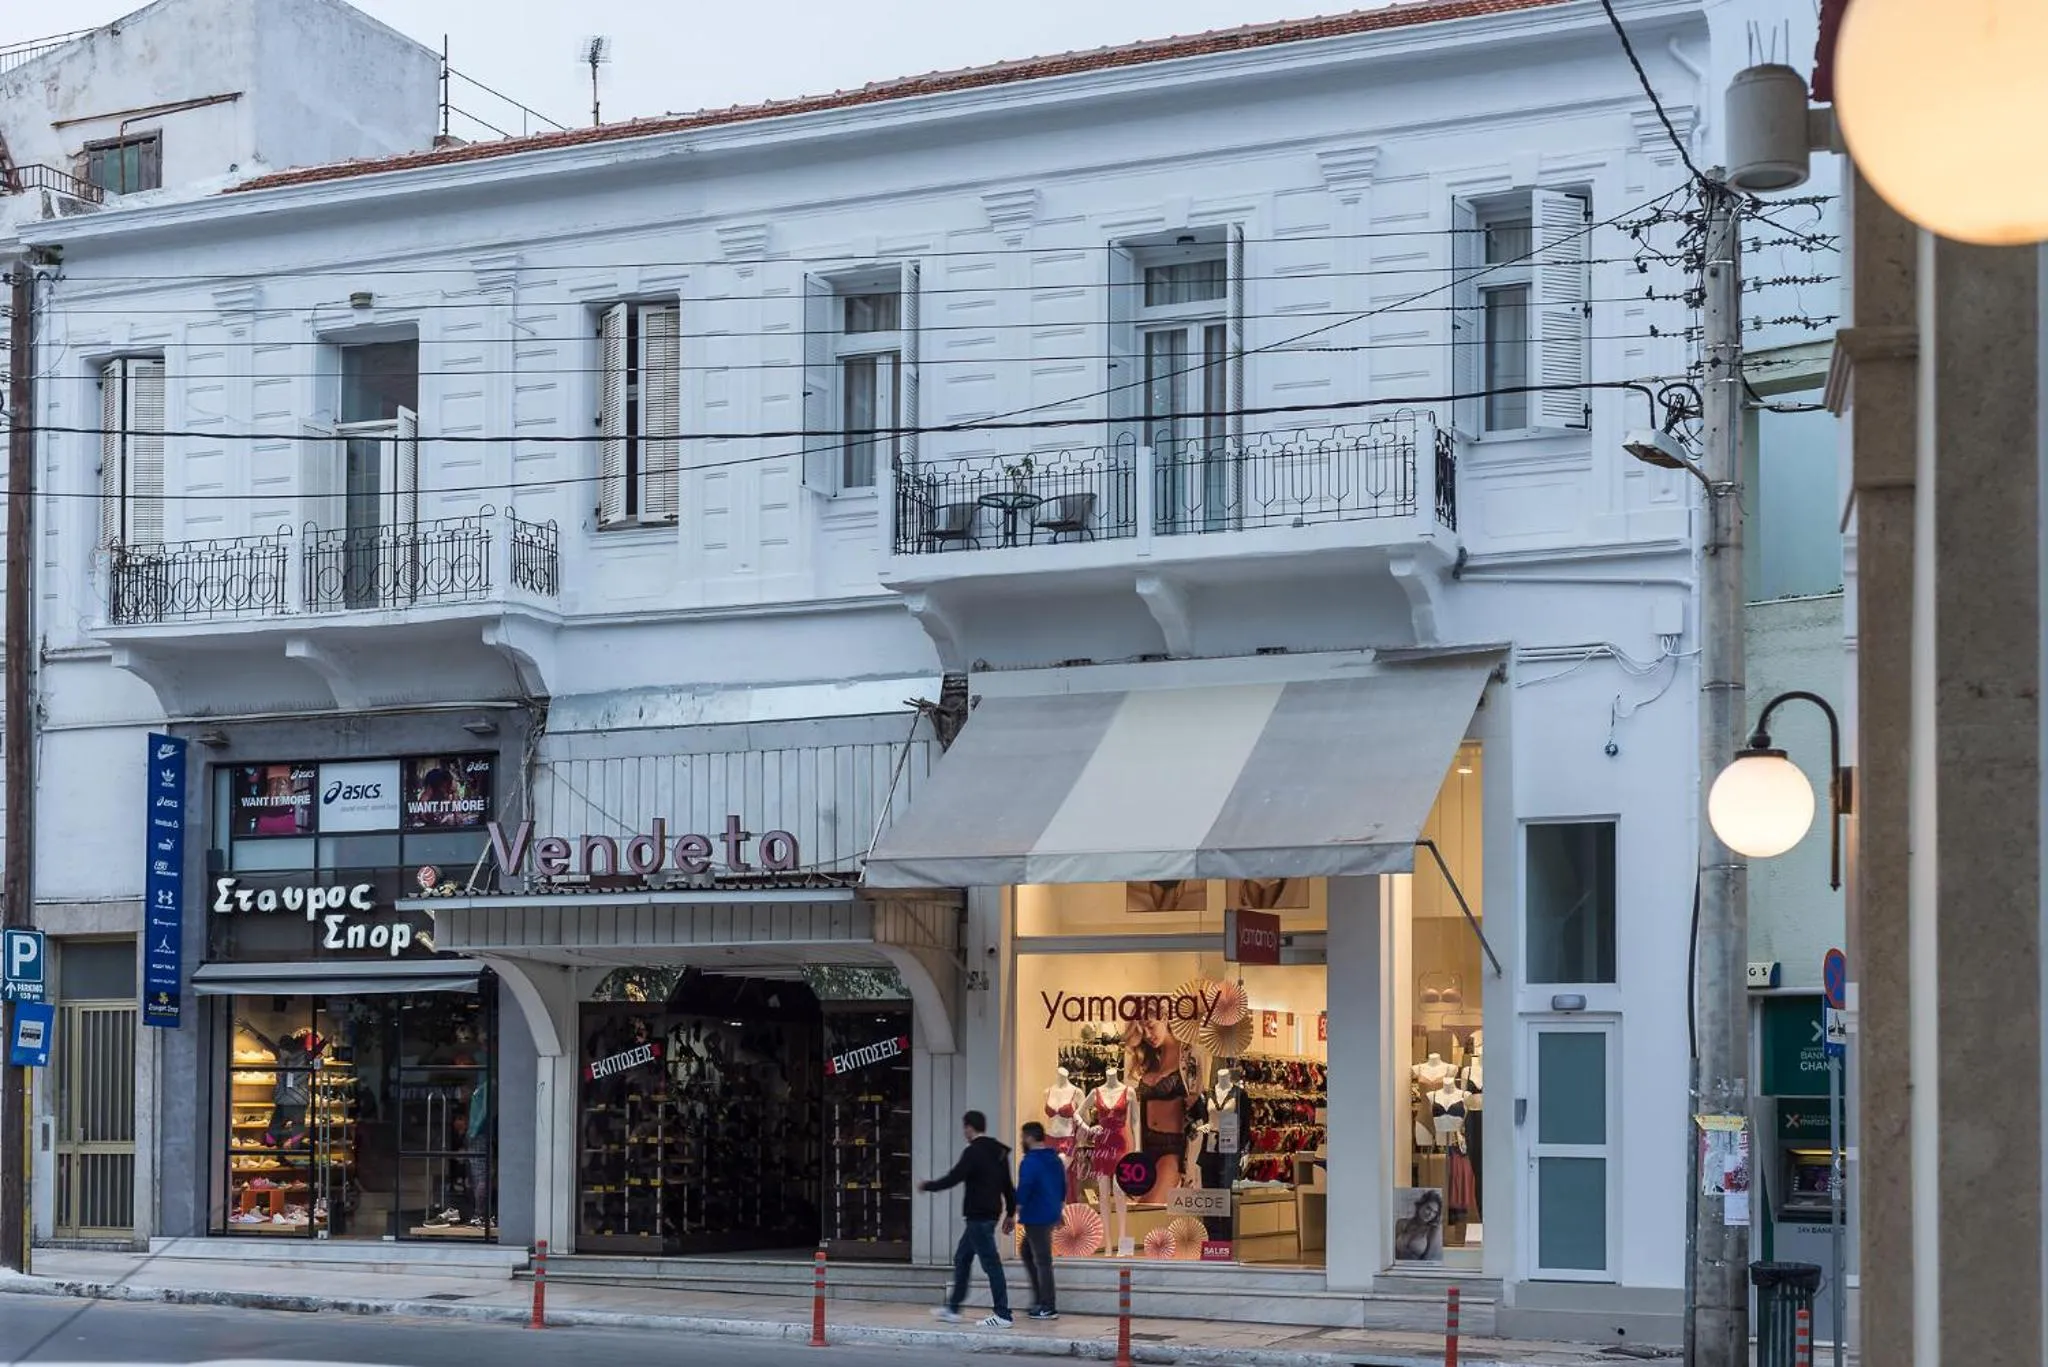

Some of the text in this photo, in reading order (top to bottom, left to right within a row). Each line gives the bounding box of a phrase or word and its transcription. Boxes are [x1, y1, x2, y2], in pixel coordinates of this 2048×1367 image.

[241, 794, 311, 807] WANT IT MORE
[342, 783, 382, 800] asics
[407, 801, 438, 813] WANT
[440, 800, 450, 812] IT
[452, 799, 485, 812] MORE
[486, 814, 800, 876] Vendeta
[213, 877, 373, 921] Σταυρος
[323, 914, 410, 956] Σπορ
[13, 934, 37, 976] P
[1040, 990, 1222, 1029] yamamay
[590, 1043, 655, 1080] ΕΚΠΤΩΣΕΙΣ
[832, 1036, 902, 1074] ΕΚΠΤΩΣΕΙΣ
[1120, 1163, 1146, 1182] 30
[1174, 1196, 1224, 1209] ABCDE
[1204, 1247, 1230, 1255] SALES
